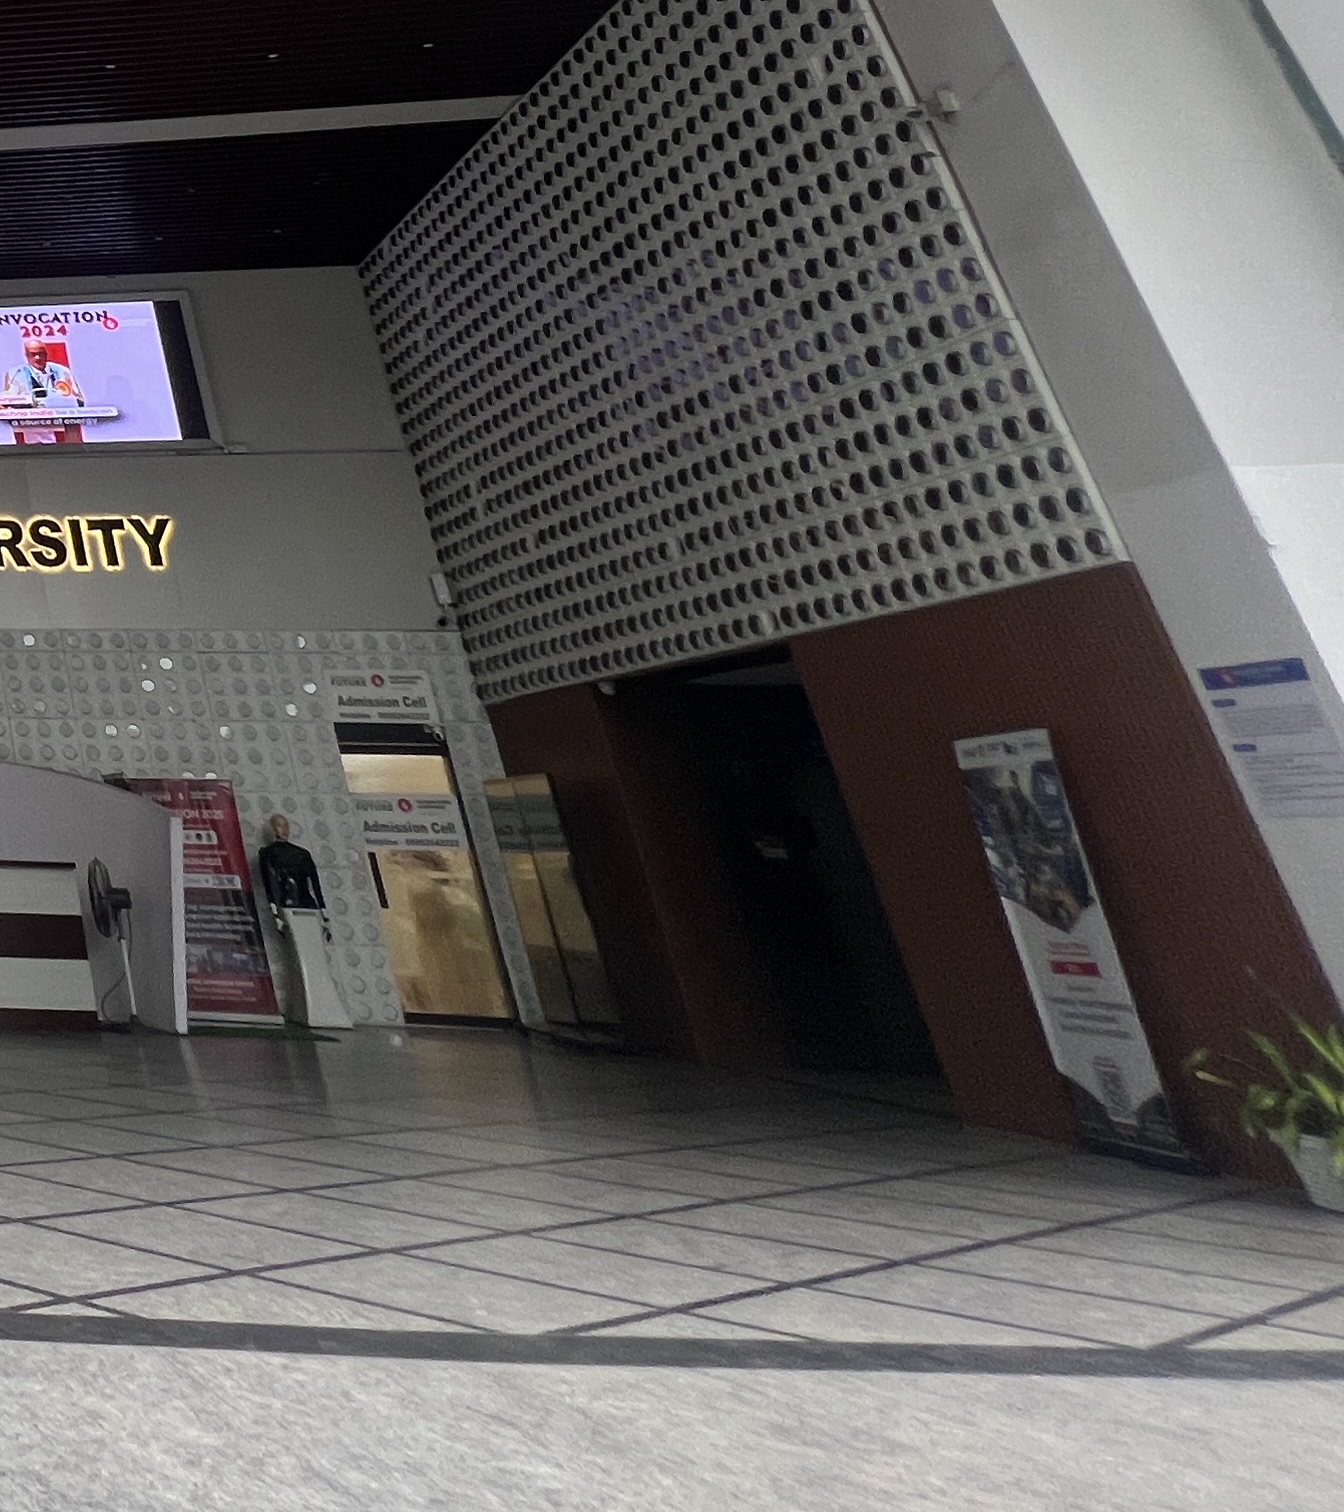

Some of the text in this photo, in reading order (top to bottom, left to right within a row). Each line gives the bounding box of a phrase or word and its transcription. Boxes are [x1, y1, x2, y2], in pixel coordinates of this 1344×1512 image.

[20, 325, 68, 338] 2024
[338, 695, 427, 708] Admission Cell
[364, 821, 456, 834] Admission Cell
